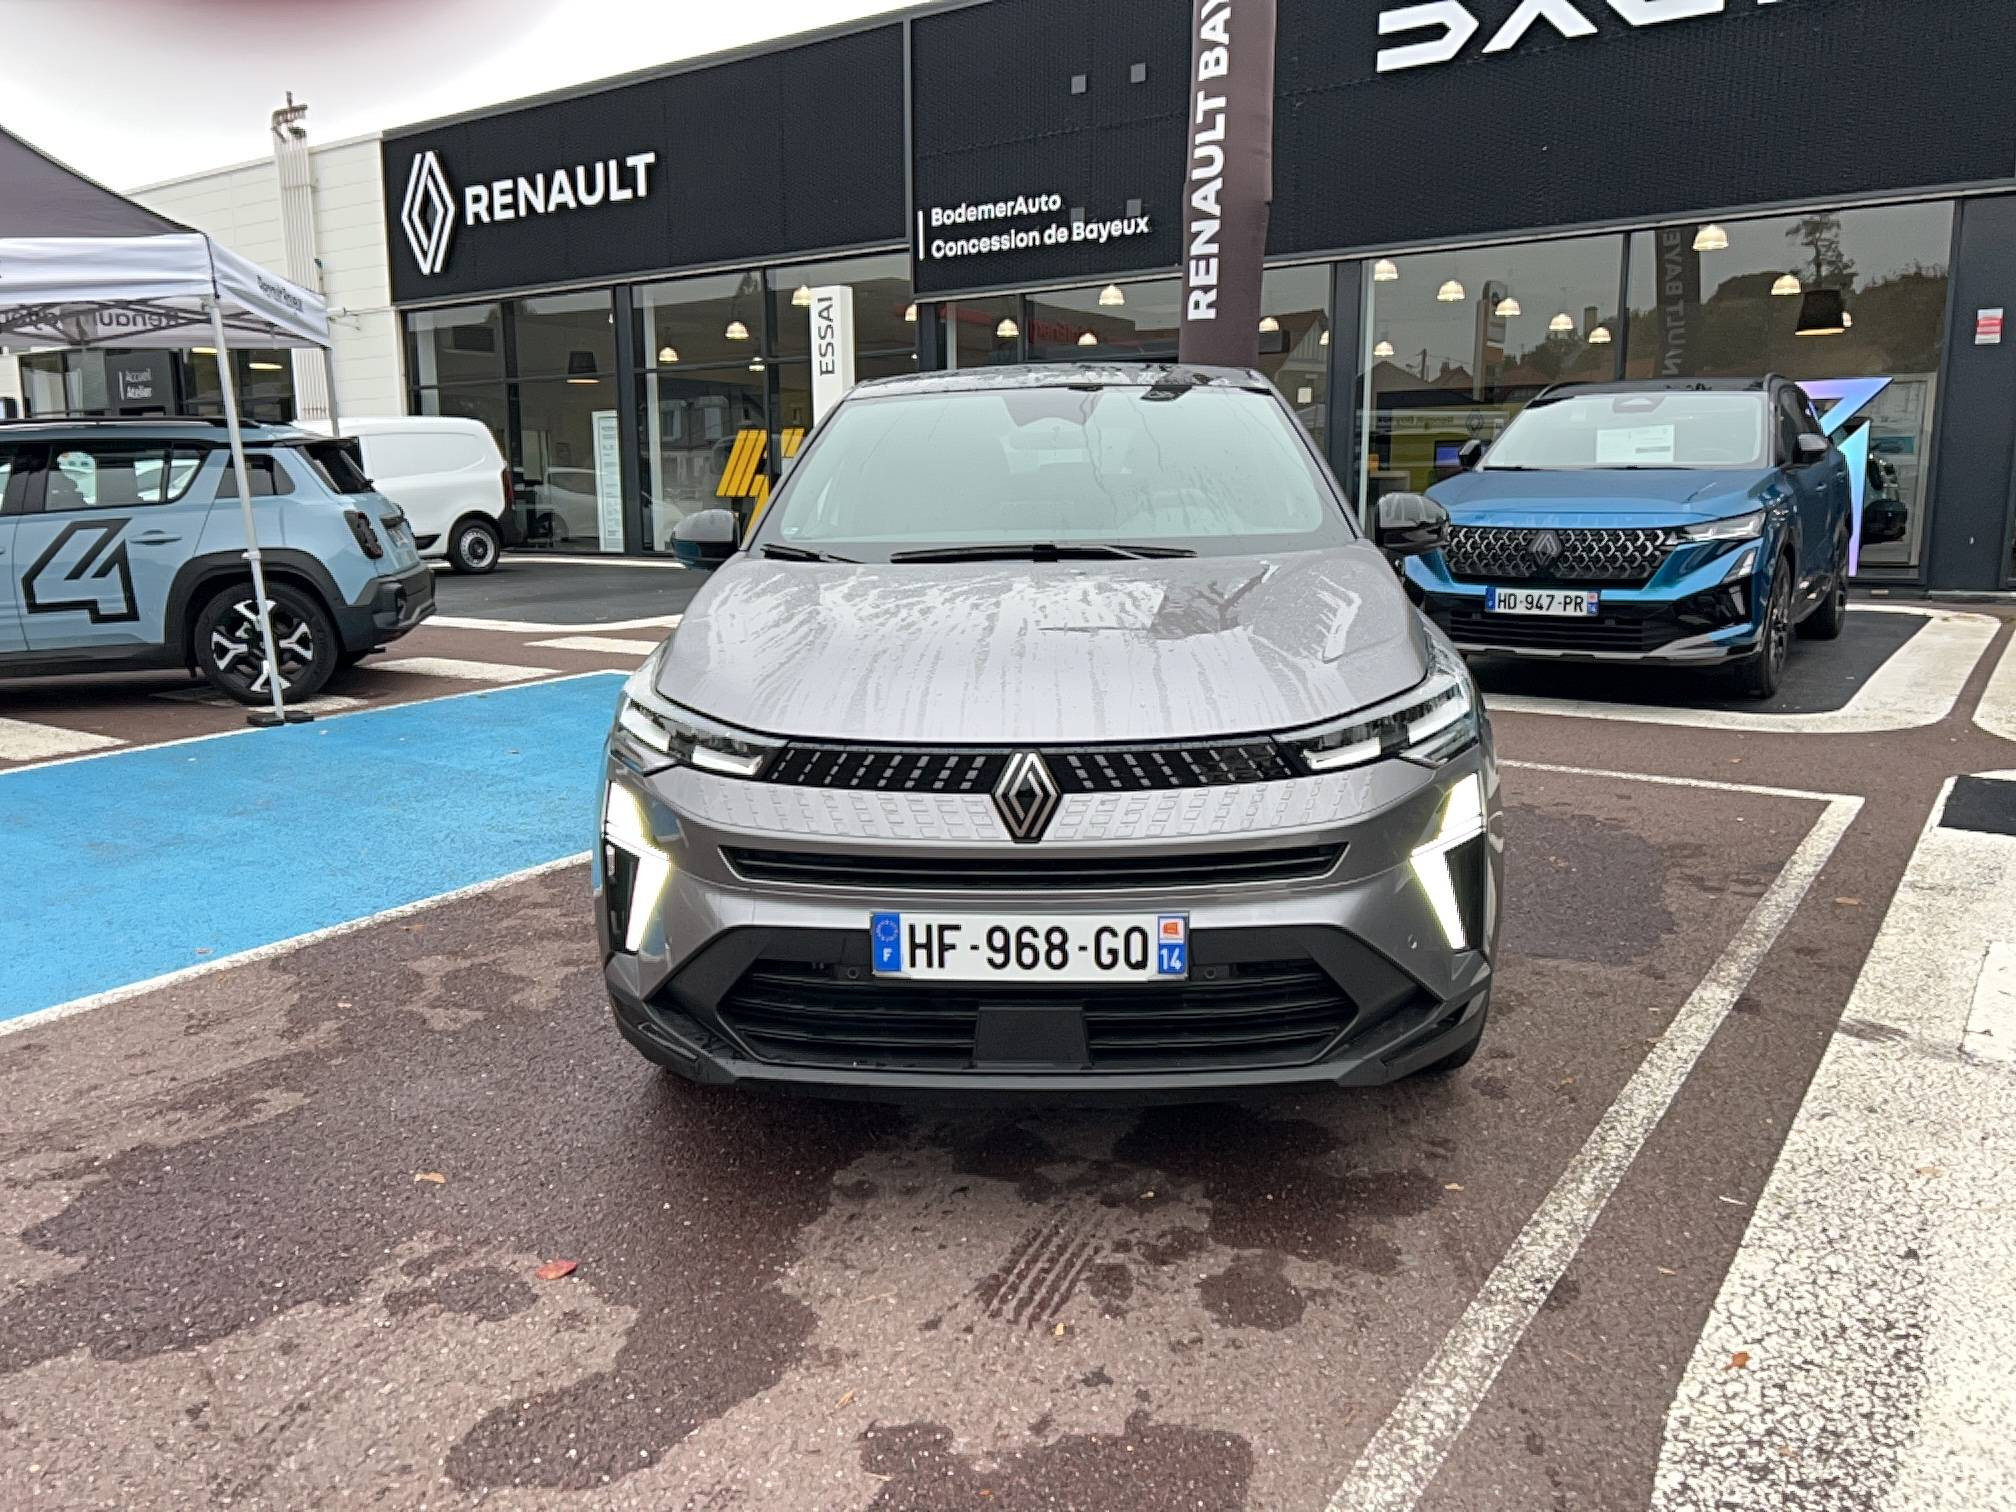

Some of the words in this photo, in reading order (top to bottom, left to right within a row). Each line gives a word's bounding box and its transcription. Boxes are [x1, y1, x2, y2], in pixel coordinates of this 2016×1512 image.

[464, 151, 656, 226] RENAULT
[930, 193, 1062, 227] BodemerAuto
[1187, 90, 1227, 321] RENAULT
[931, 228, 1040, 259] Concession
[1043, 223, 1069, 245] de
[1071, 215, 1150, 244] Bayeux
[817, 296, 835, 376] ESSAI
[1498, 593, 1584, 612] HD-947-PR
[883, 948, 892, 962] F
[908, 923, 1149, 970] HF-968-GQ
[1160, 947, 1182, 970] 14
